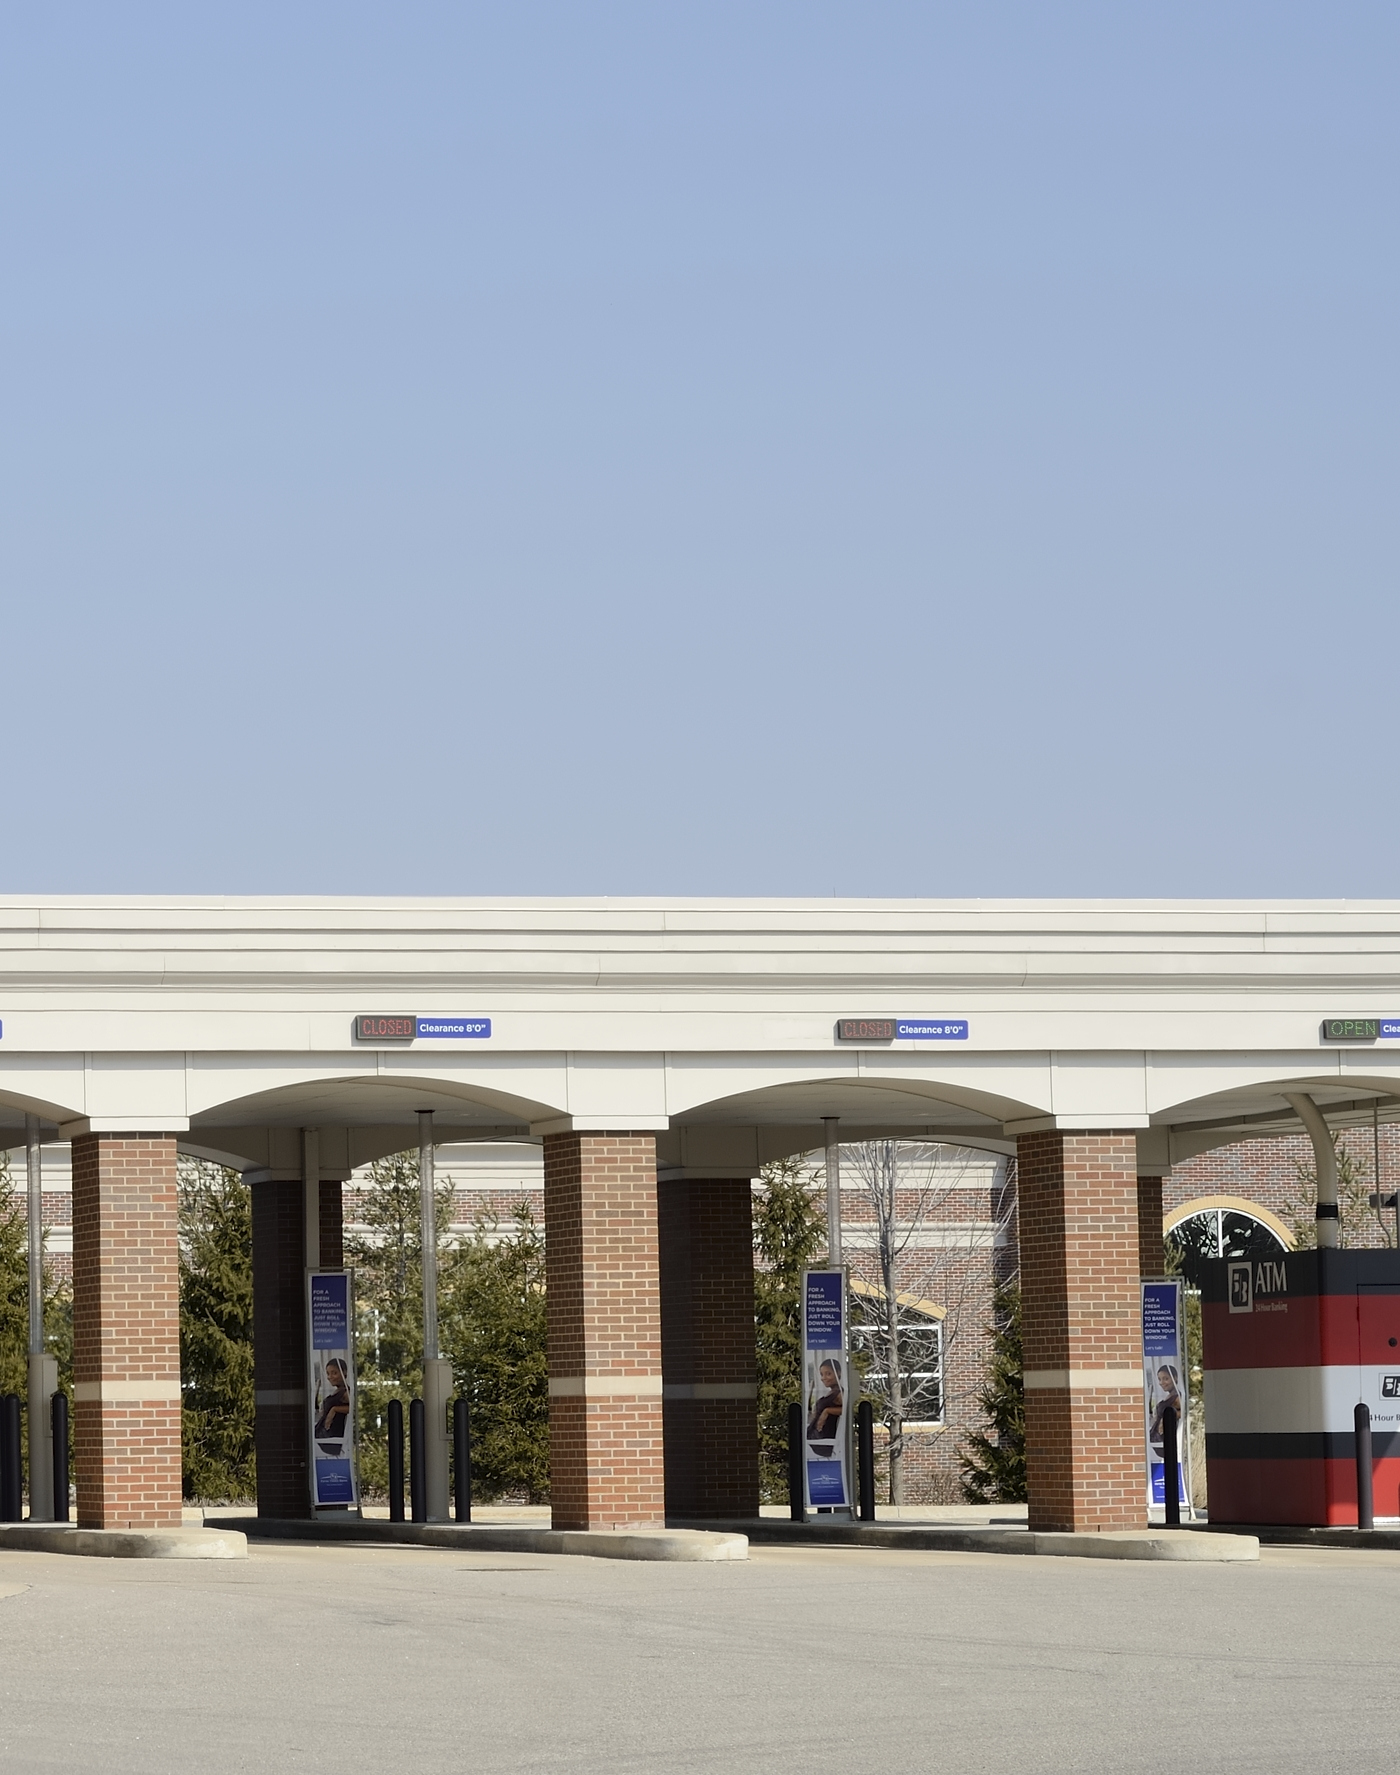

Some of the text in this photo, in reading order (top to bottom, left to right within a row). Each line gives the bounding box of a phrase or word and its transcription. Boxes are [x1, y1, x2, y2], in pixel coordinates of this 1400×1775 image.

[363, 1020, 412, 1035] CLOSED
[420, 1024, 464, 1032] Clearance
[844, 1022, 892, 1037] CLOSED
[1331, 1021, 1376, 1036] OPEN
[1256, 1261, 1287, 1294] ATM
[1272, 1301, 1287, 1313] Banking
